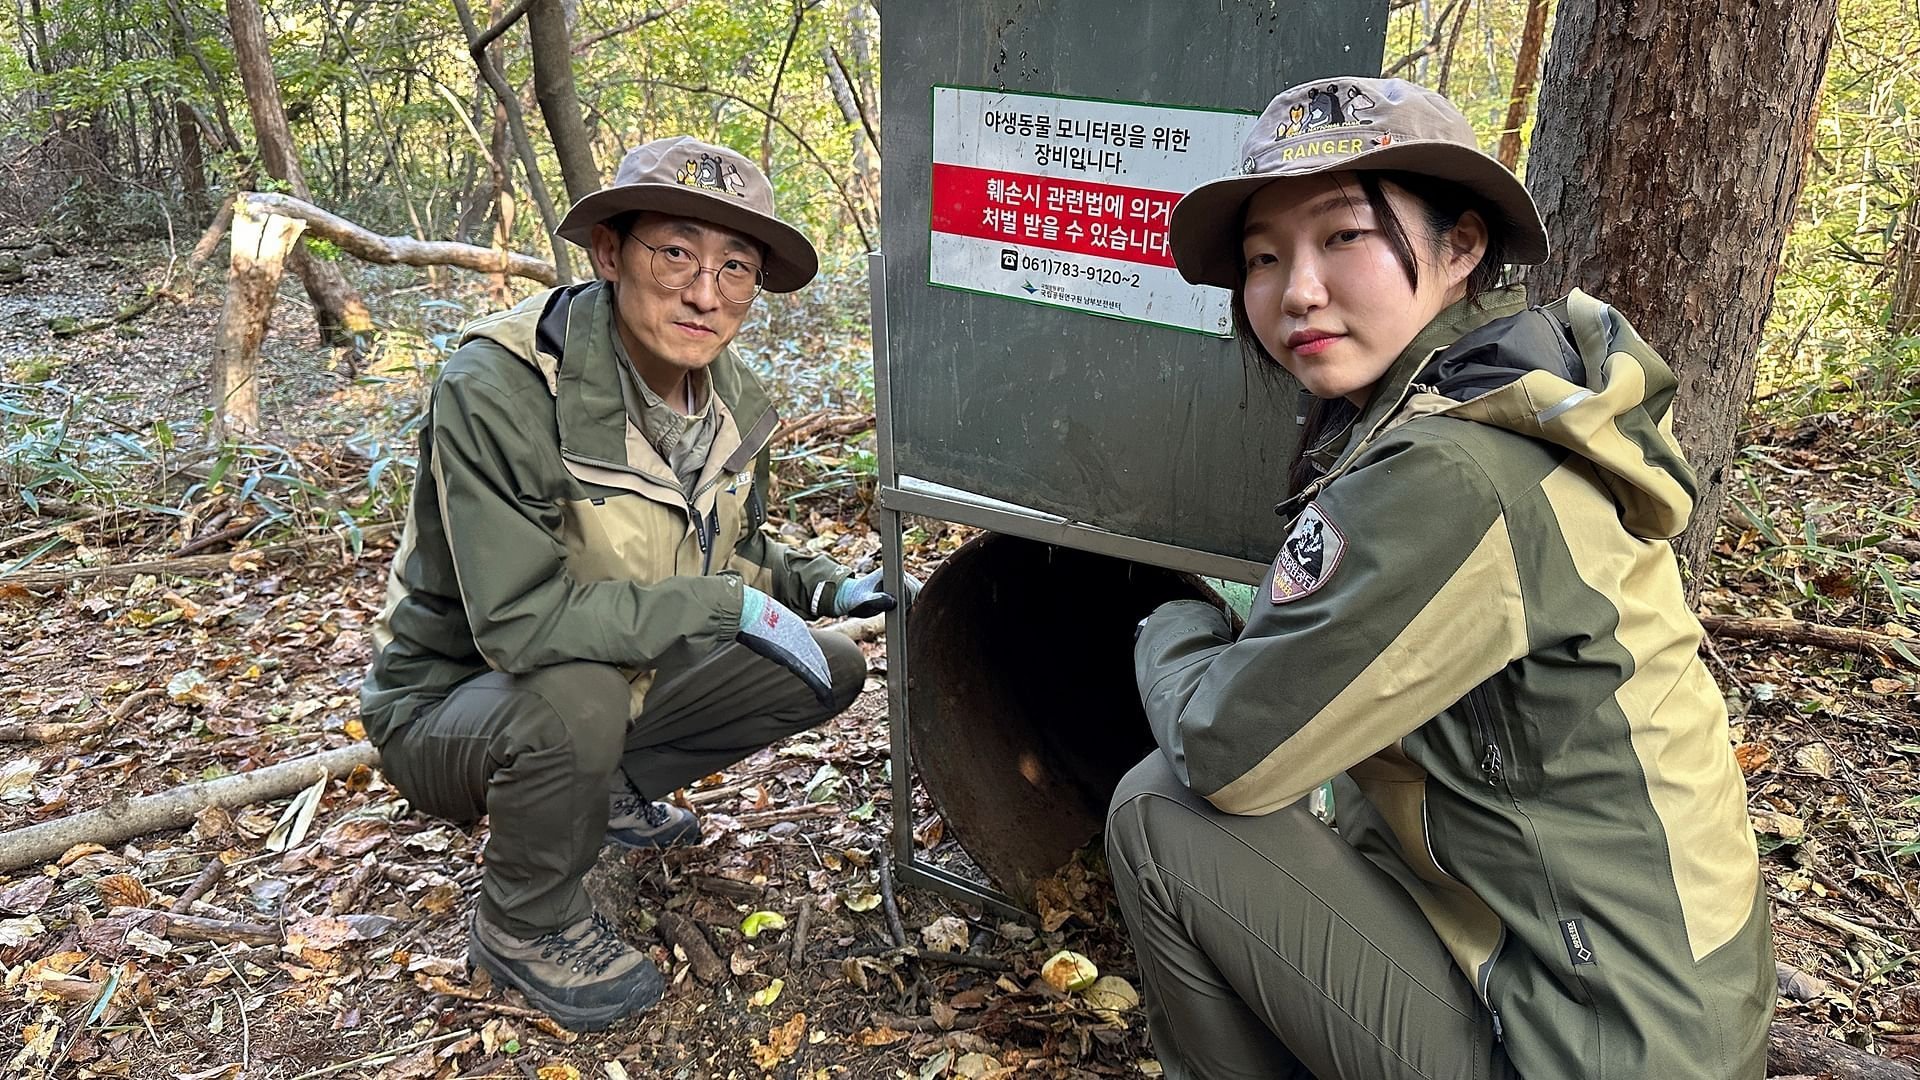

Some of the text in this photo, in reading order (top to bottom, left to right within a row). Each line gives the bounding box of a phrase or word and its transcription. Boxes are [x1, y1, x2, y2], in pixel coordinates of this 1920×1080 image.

[985, 111, 1190, 153] 야생동물 모니터링을 위한
[1034, 143, 1127, 174] 장비입니다.
[1282, 139, 1363, 161] RANGER
[987, 178, 1171, 226] 훼손시 관련법에 의거
[982, 207, 1017, 235] 처벌
[1023, 213, 1060, 241] 받을
[1065, 220, 1084, 244] 수
[1022, 256, 1140, 288] 061)783-9120~2
